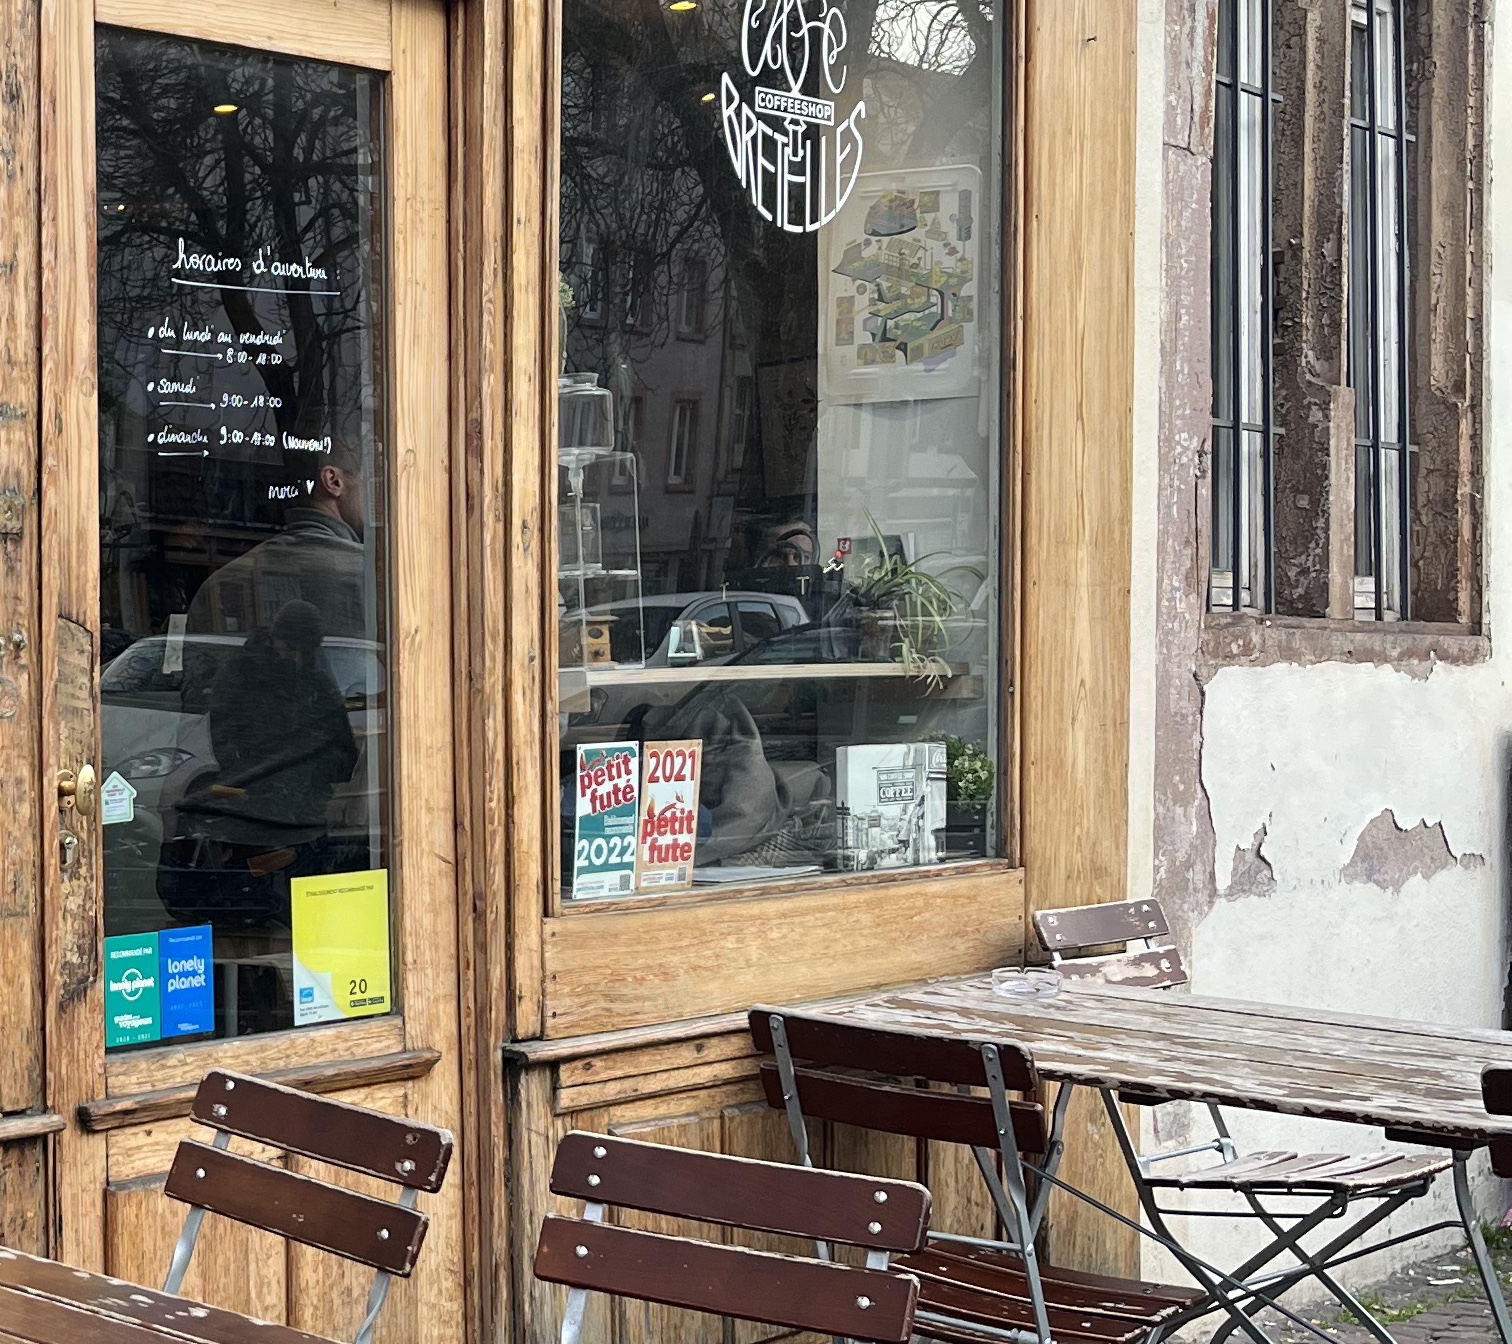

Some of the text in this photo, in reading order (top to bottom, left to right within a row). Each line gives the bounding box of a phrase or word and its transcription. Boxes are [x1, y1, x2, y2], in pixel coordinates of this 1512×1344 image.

[758, 92, 832, 119] COFFEESHOP
[721, 72, 866, 233] BRETELLES
[172, 237, 241, 272] horaires
[159, 317, 176, 338] du
[183, 322, 215, 342] lundi
[578, 751, 633, 798] petit
[648, 748, 697, 784] 2021
[589, 778, 635, 816] futé
[879, 785, 914, 799] COFFEE
[641, 808, 695, 845] petit
[576, 835, 636, 867] 2022
[168, 955, 205, 974] lonely
[168, 974, 206, 993] planet
[349, 978, 368, 996] 20
